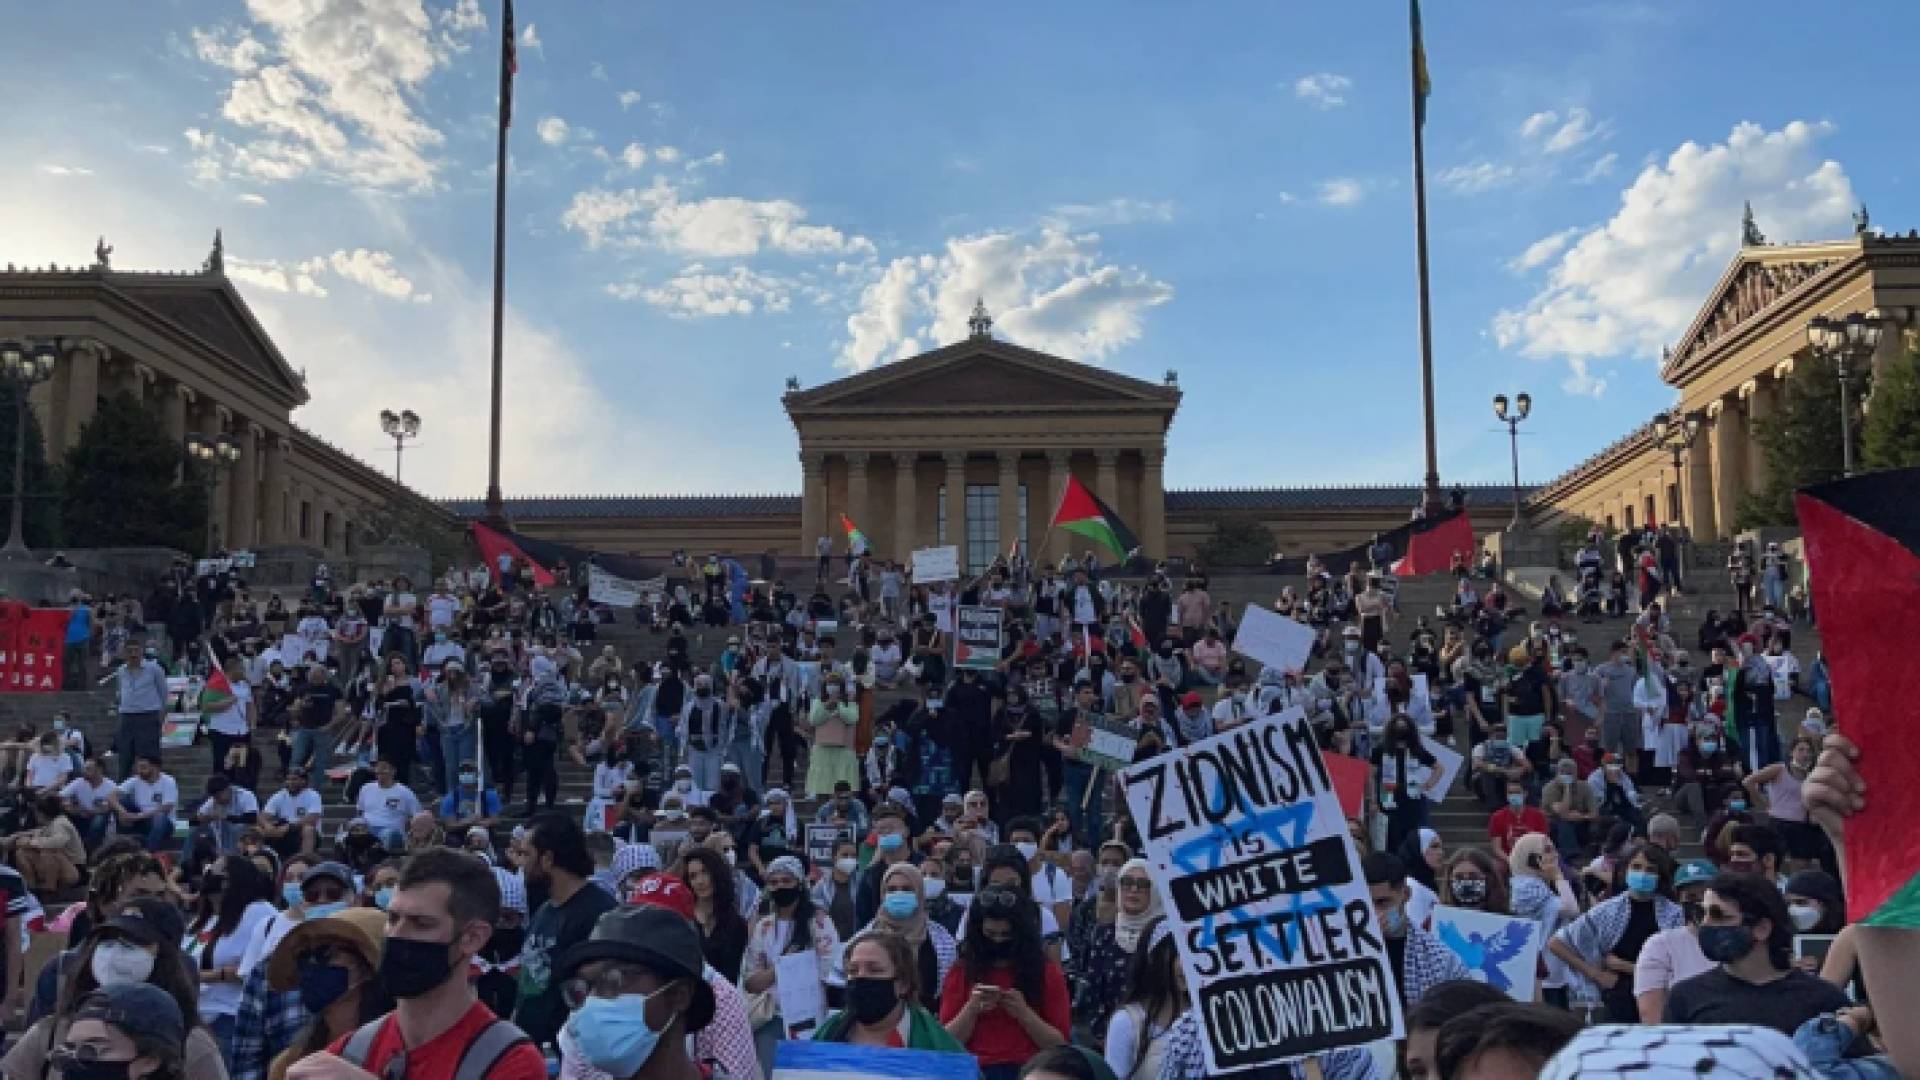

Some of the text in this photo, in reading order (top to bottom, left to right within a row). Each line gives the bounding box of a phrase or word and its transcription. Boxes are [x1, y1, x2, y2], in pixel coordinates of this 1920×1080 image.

[1122, 717, 1331, 840] ZIONISM
[1192, 850, 1317, 914] WHITE
[1225, 829, 1265, 857] IS
[1187, 898, 1383, 977] SETTLER
[1208, 965, 1387, 1055] COLONIALISM
